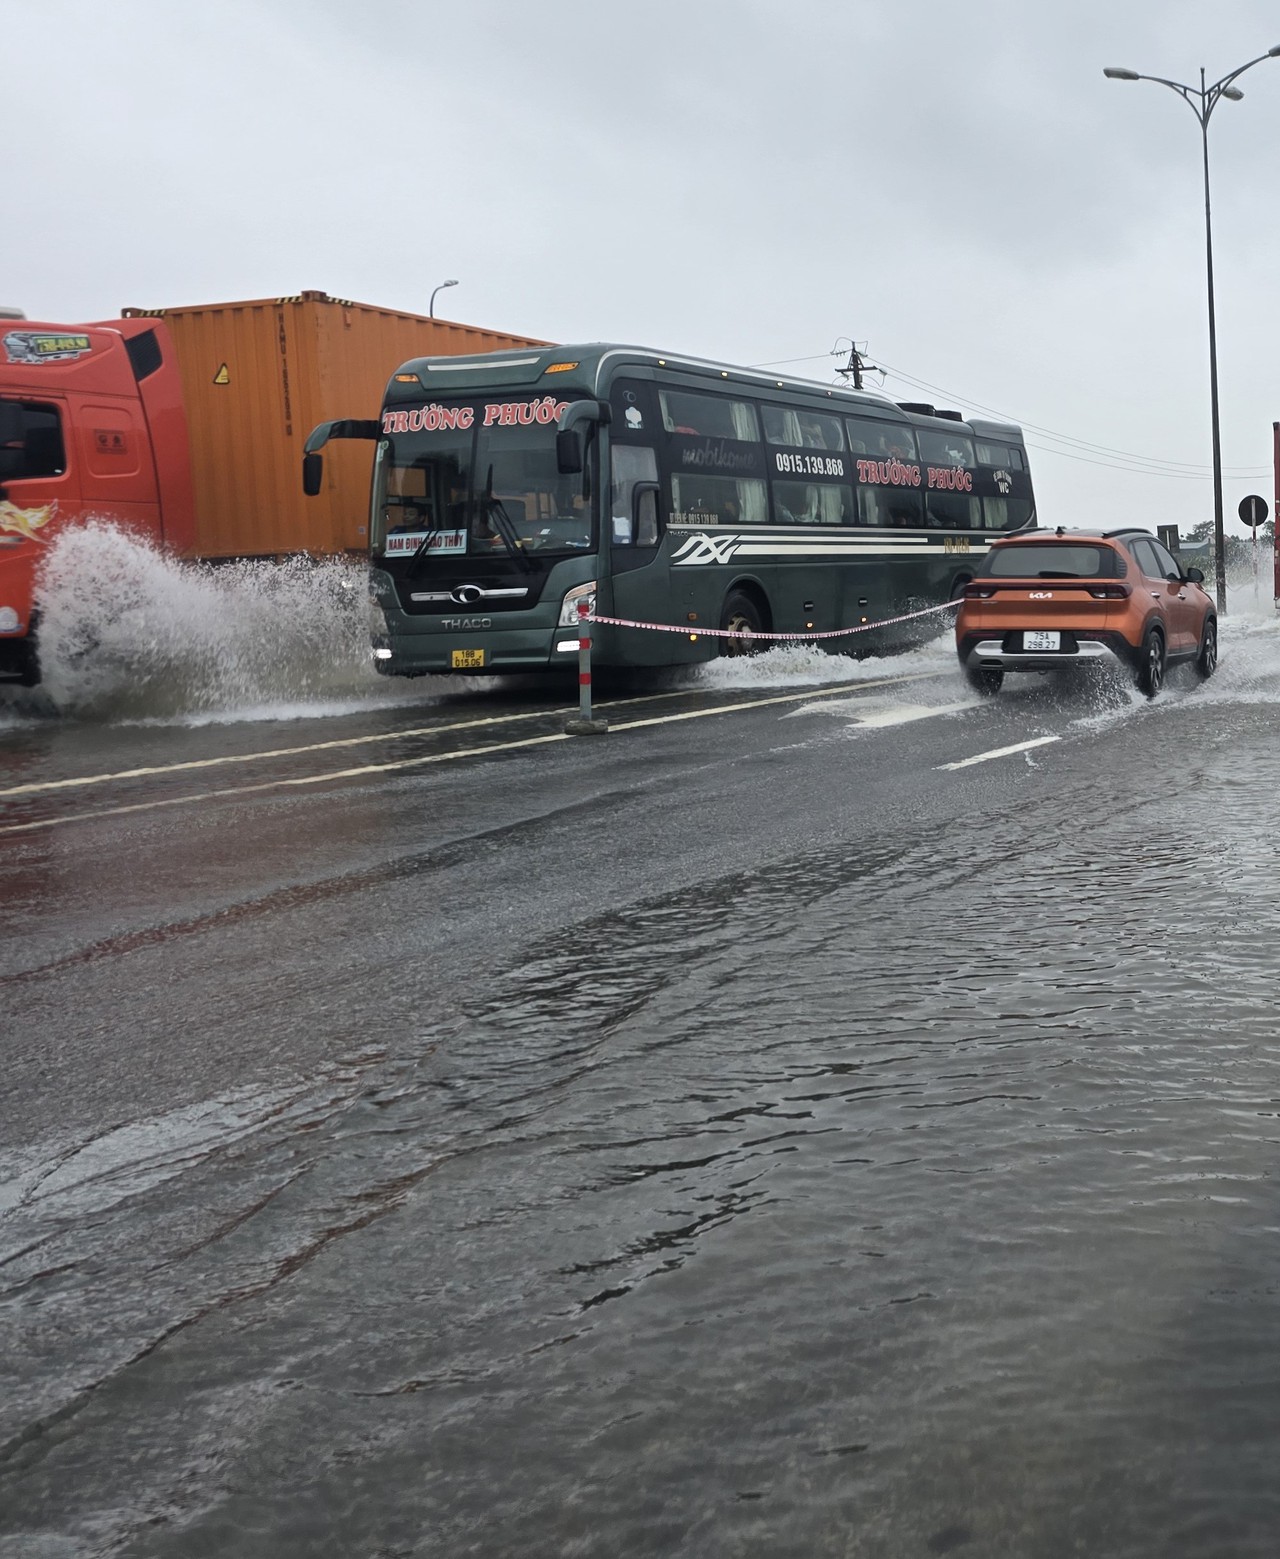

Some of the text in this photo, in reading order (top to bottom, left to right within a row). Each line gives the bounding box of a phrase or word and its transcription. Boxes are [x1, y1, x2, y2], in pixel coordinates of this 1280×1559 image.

[382, 403, 475, 434] TRƯỜNG
[775, 453, 844, 477] 0915.139.868
[857, 456, 922, 487] TRƯỜNG
[926, 465, 973, 492] PHƯỚC
[998, 481, 1010, 494] WC
[388, 538, 404, 551] NAM
[441, 618, 491, 629] THACO
[1034, 632, 1050, 640] 75A
